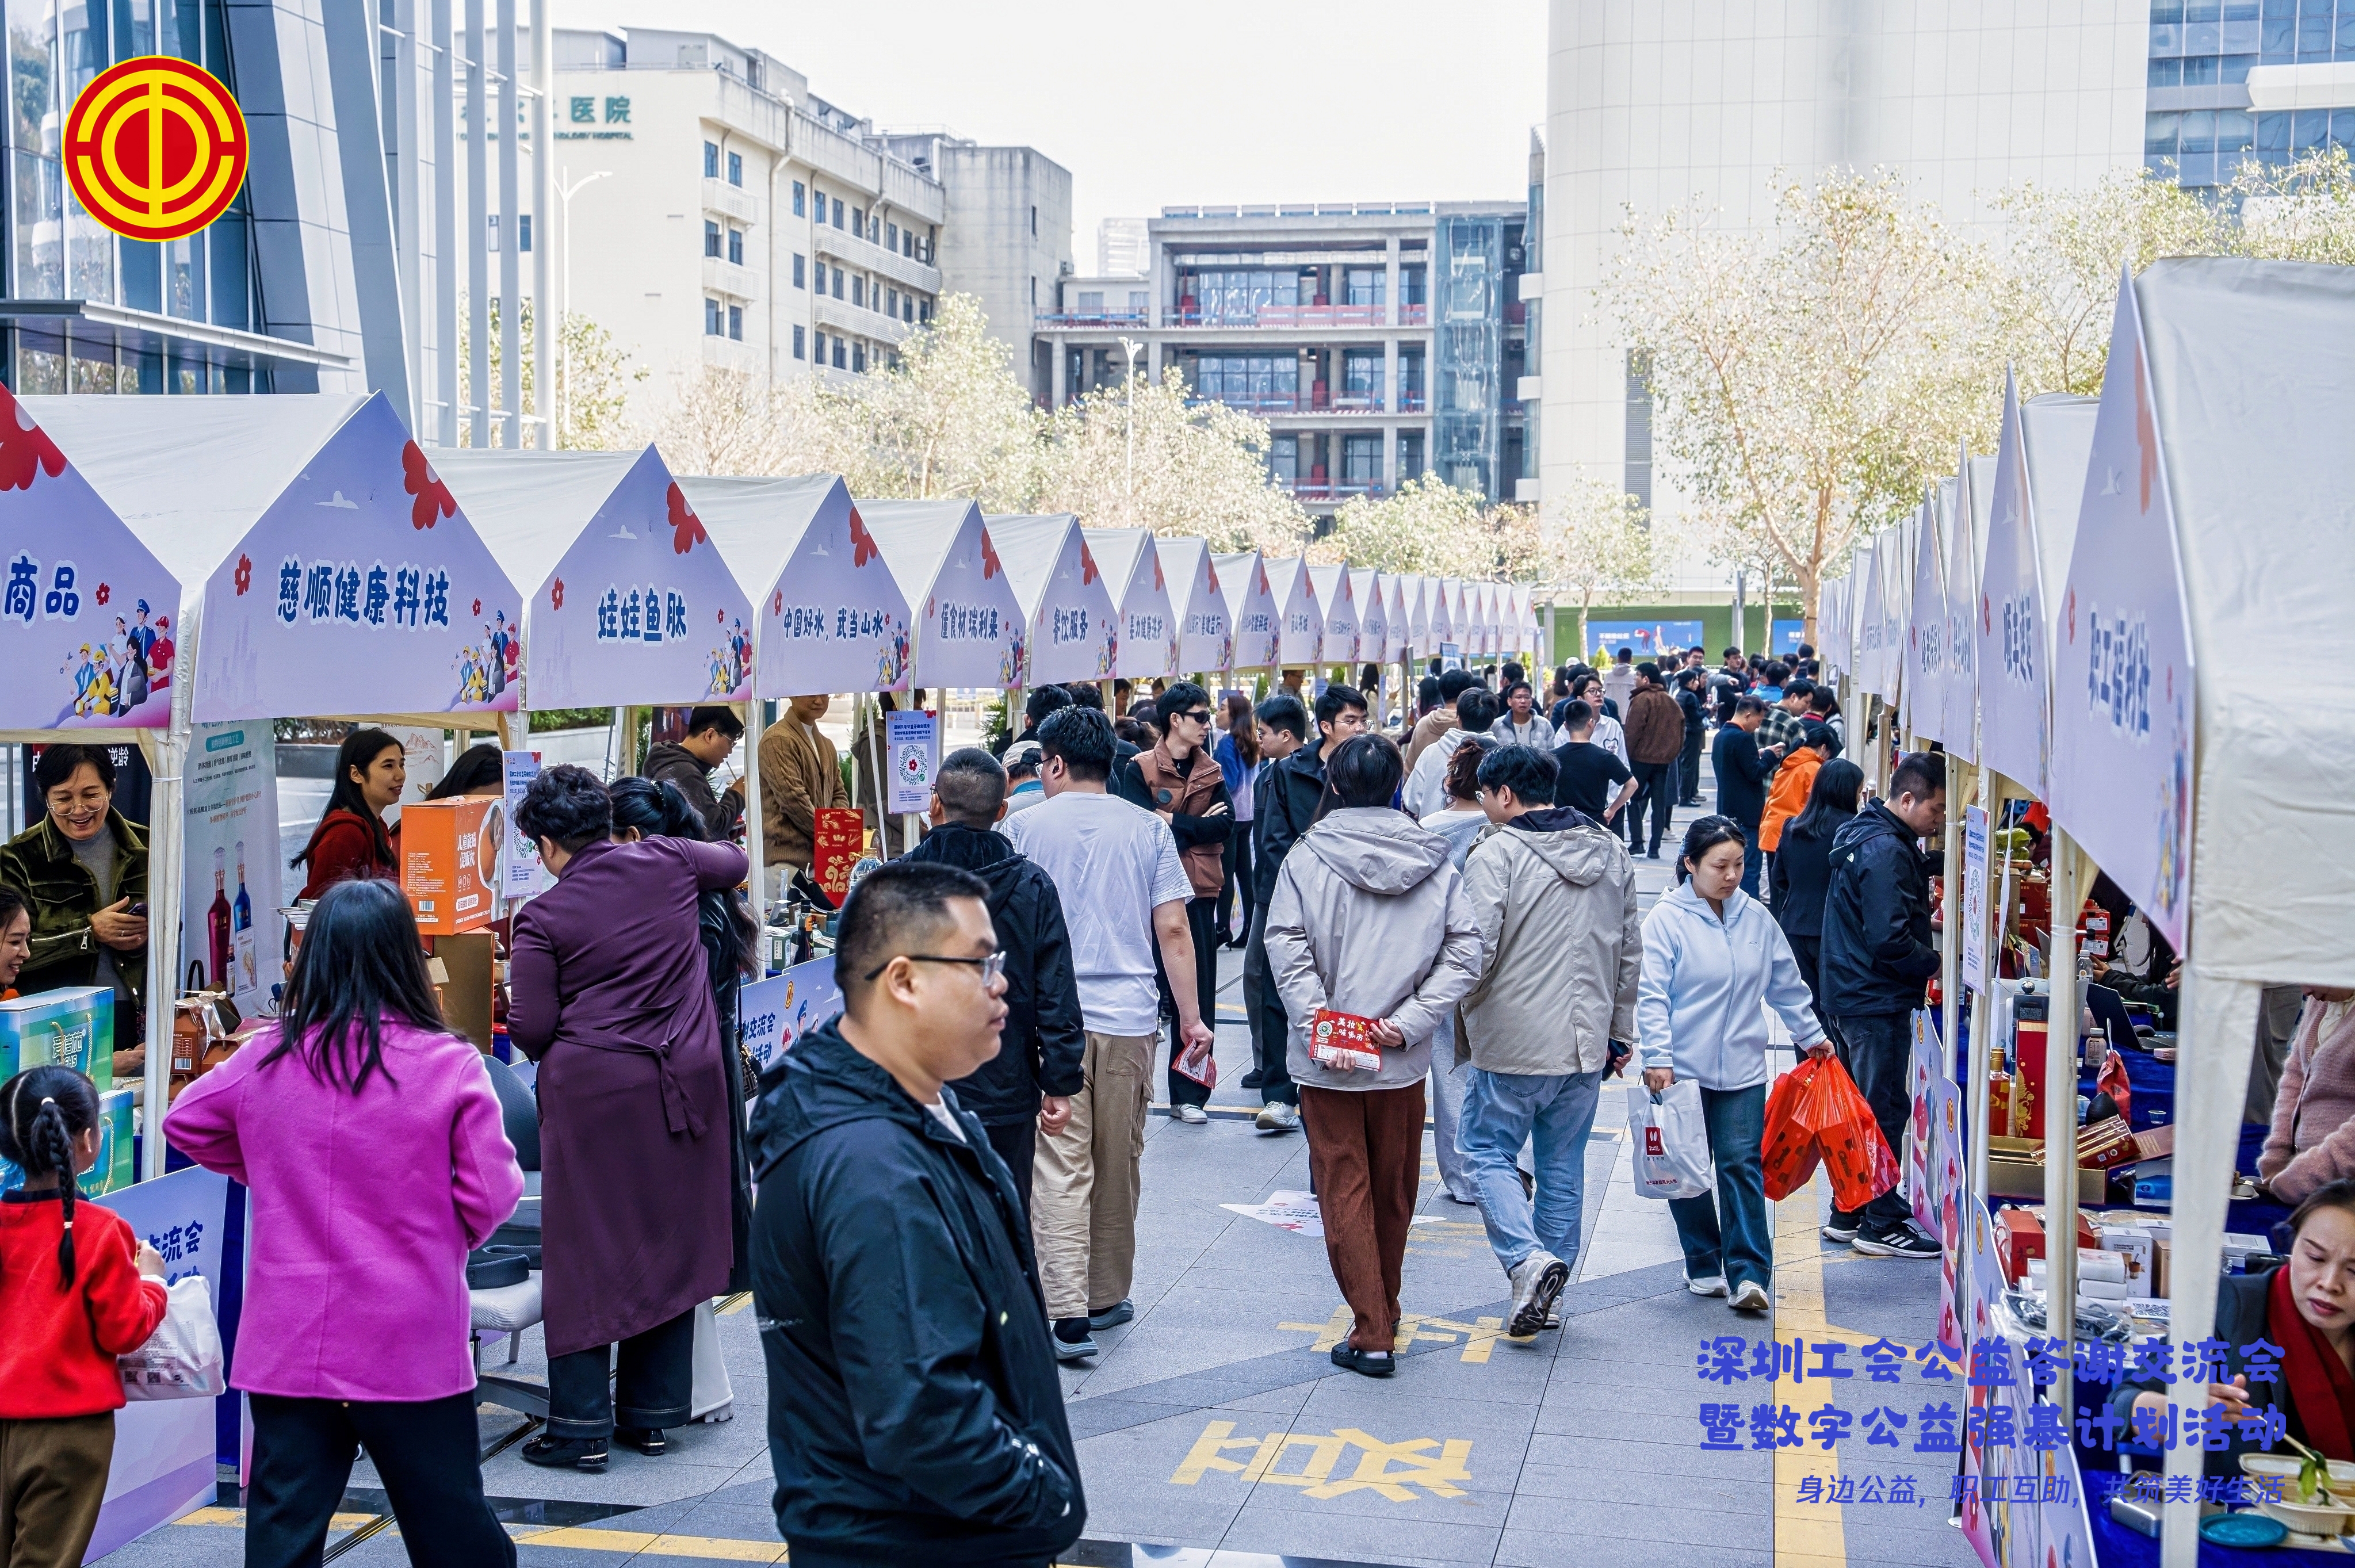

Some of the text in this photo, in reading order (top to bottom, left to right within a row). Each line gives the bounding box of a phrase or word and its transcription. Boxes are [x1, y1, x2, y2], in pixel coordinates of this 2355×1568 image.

[279, 559, 450, 626] 慈顺健康科技
[598, 587, 686, 643] 娃娃鱼肽
[1053, 606, 1088, 645] 餐饮服务
[460, 851, 475, 870] 促眠枕
